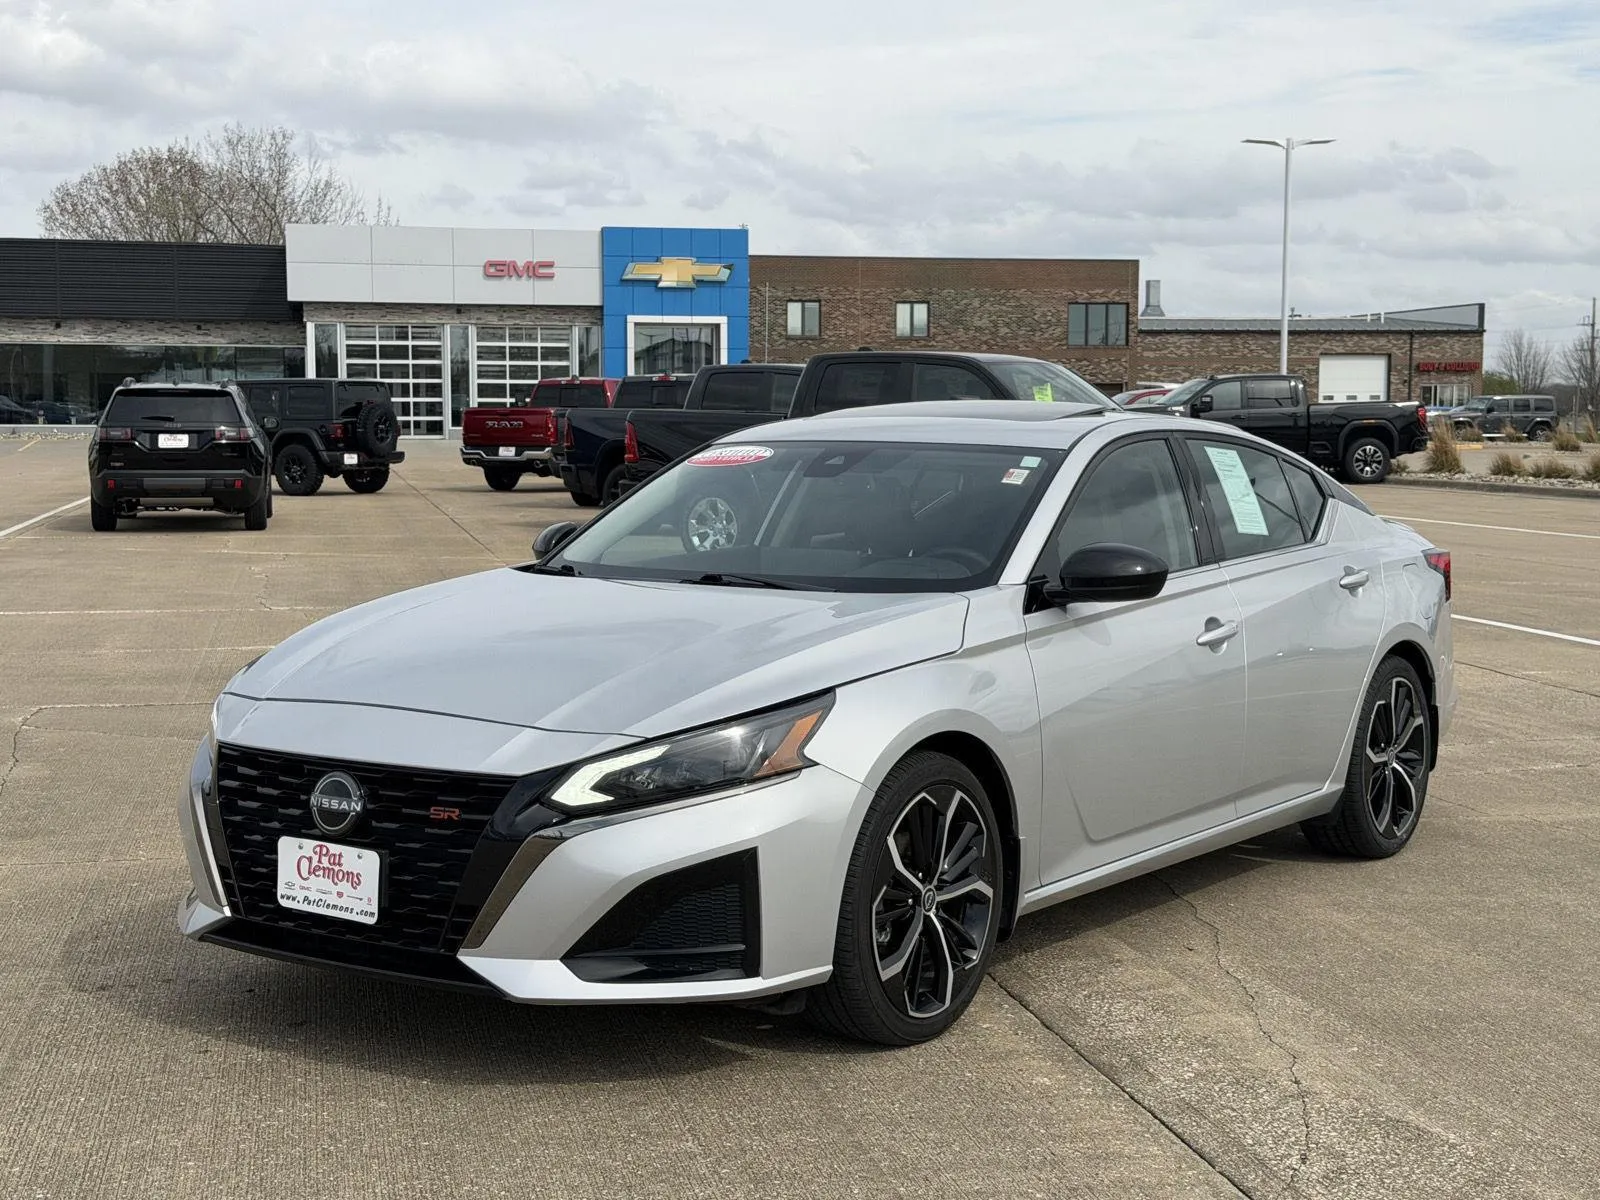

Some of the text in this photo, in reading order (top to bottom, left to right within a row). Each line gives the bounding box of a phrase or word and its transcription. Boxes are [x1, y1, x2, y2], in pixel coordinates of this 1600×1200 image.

[484, 260, 555, 278] GMC
[310, 796, 362, 812] NISSAN
[429, 806, 461, 820] SR
[312, 843, 344, 867] Pat
[296, 854, 363, 890] Clemons
[280, 892, 376, 918] www.PatClemons.com
